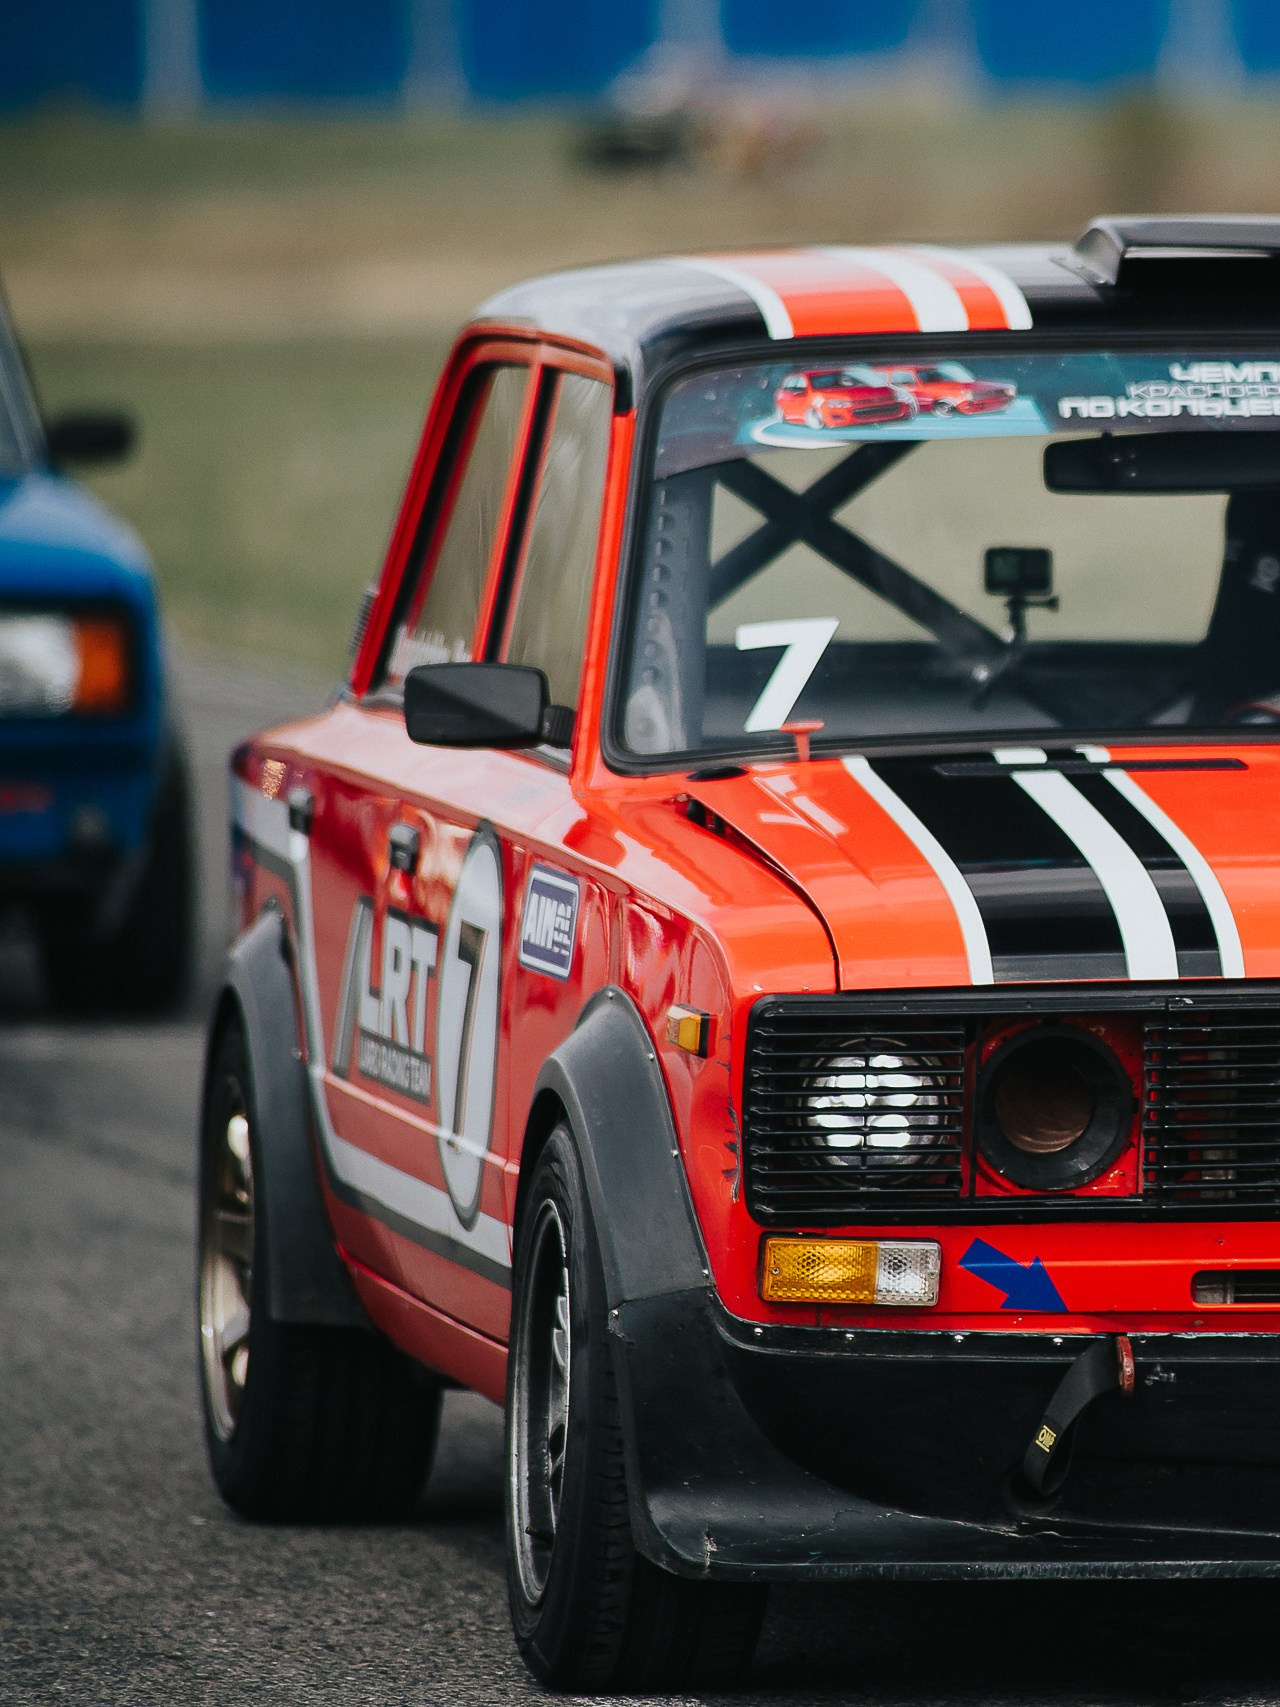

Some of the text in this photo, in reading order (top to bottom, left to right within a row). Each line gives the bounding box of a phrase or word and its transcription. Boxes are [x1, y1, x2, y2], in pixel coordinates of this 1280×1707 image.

[1060, 397, 1115, 419] ПО
[736, 617, 840, 733] 7
[357, 905, 438, 1053] LRT
[453, 920, 489, 1147] 7
